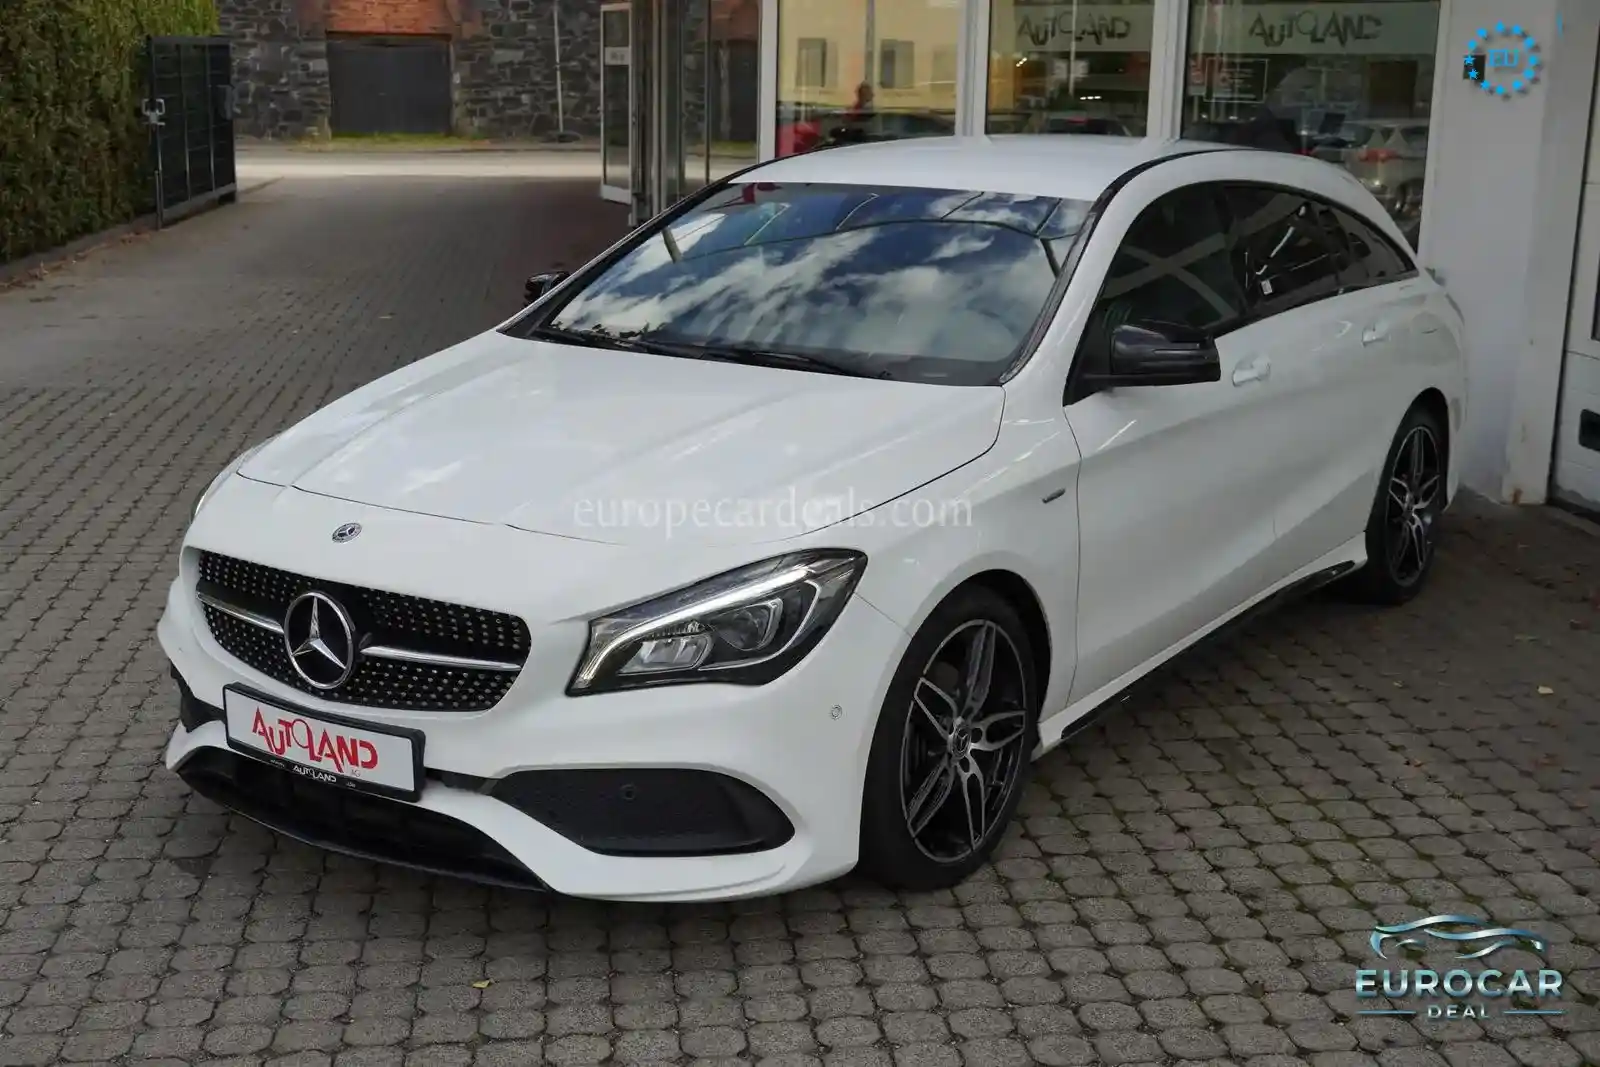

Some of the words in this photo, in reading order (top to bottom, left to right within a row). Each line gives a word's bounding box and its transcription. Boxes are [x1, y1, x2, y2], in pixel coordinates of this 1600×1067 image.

[1249, 10, 1384, 47] AUTOLAND
[251, 706, 379, 774] AUTOLAND
[293, 764, 337, 784] AUTOLAND
